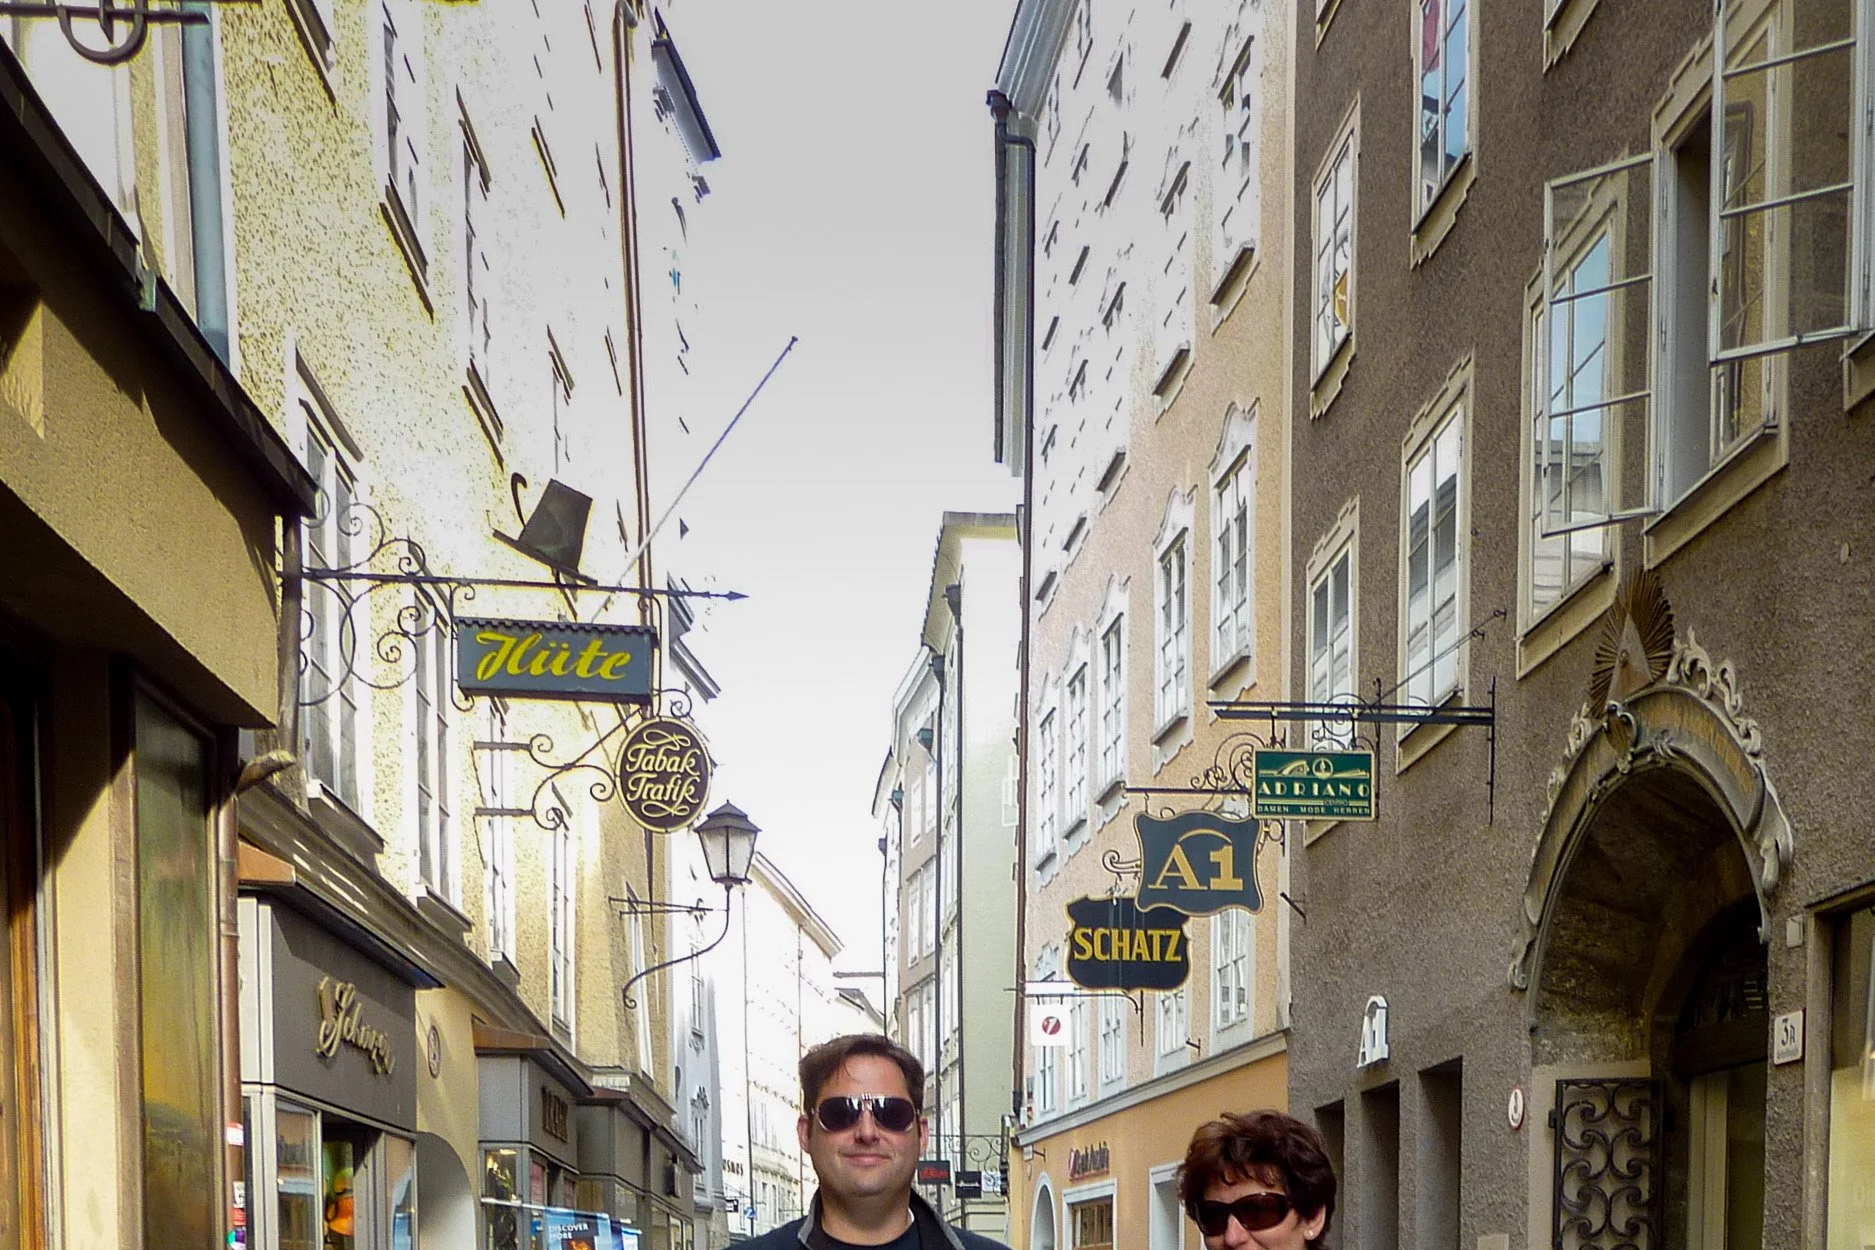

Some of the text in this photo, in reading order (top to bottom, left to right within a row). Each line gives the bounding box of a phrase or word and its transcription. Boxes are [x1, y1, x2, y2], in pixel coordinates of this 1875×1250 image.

[476, 630, 632, 682] Hüte
[626, 741, 701, 776] Tabak
[626, 773, 701, 804] Trafik
[1258, 781, 1370, 797] ADRIANO
[1257, 805, 1370, 815] DAMEN MODE HERREN
[1148, 843, 1244, 891] A1
[1073, 928, 1182, 963] SCHATZ
[1357, 1008, 1389, 1069] A1
